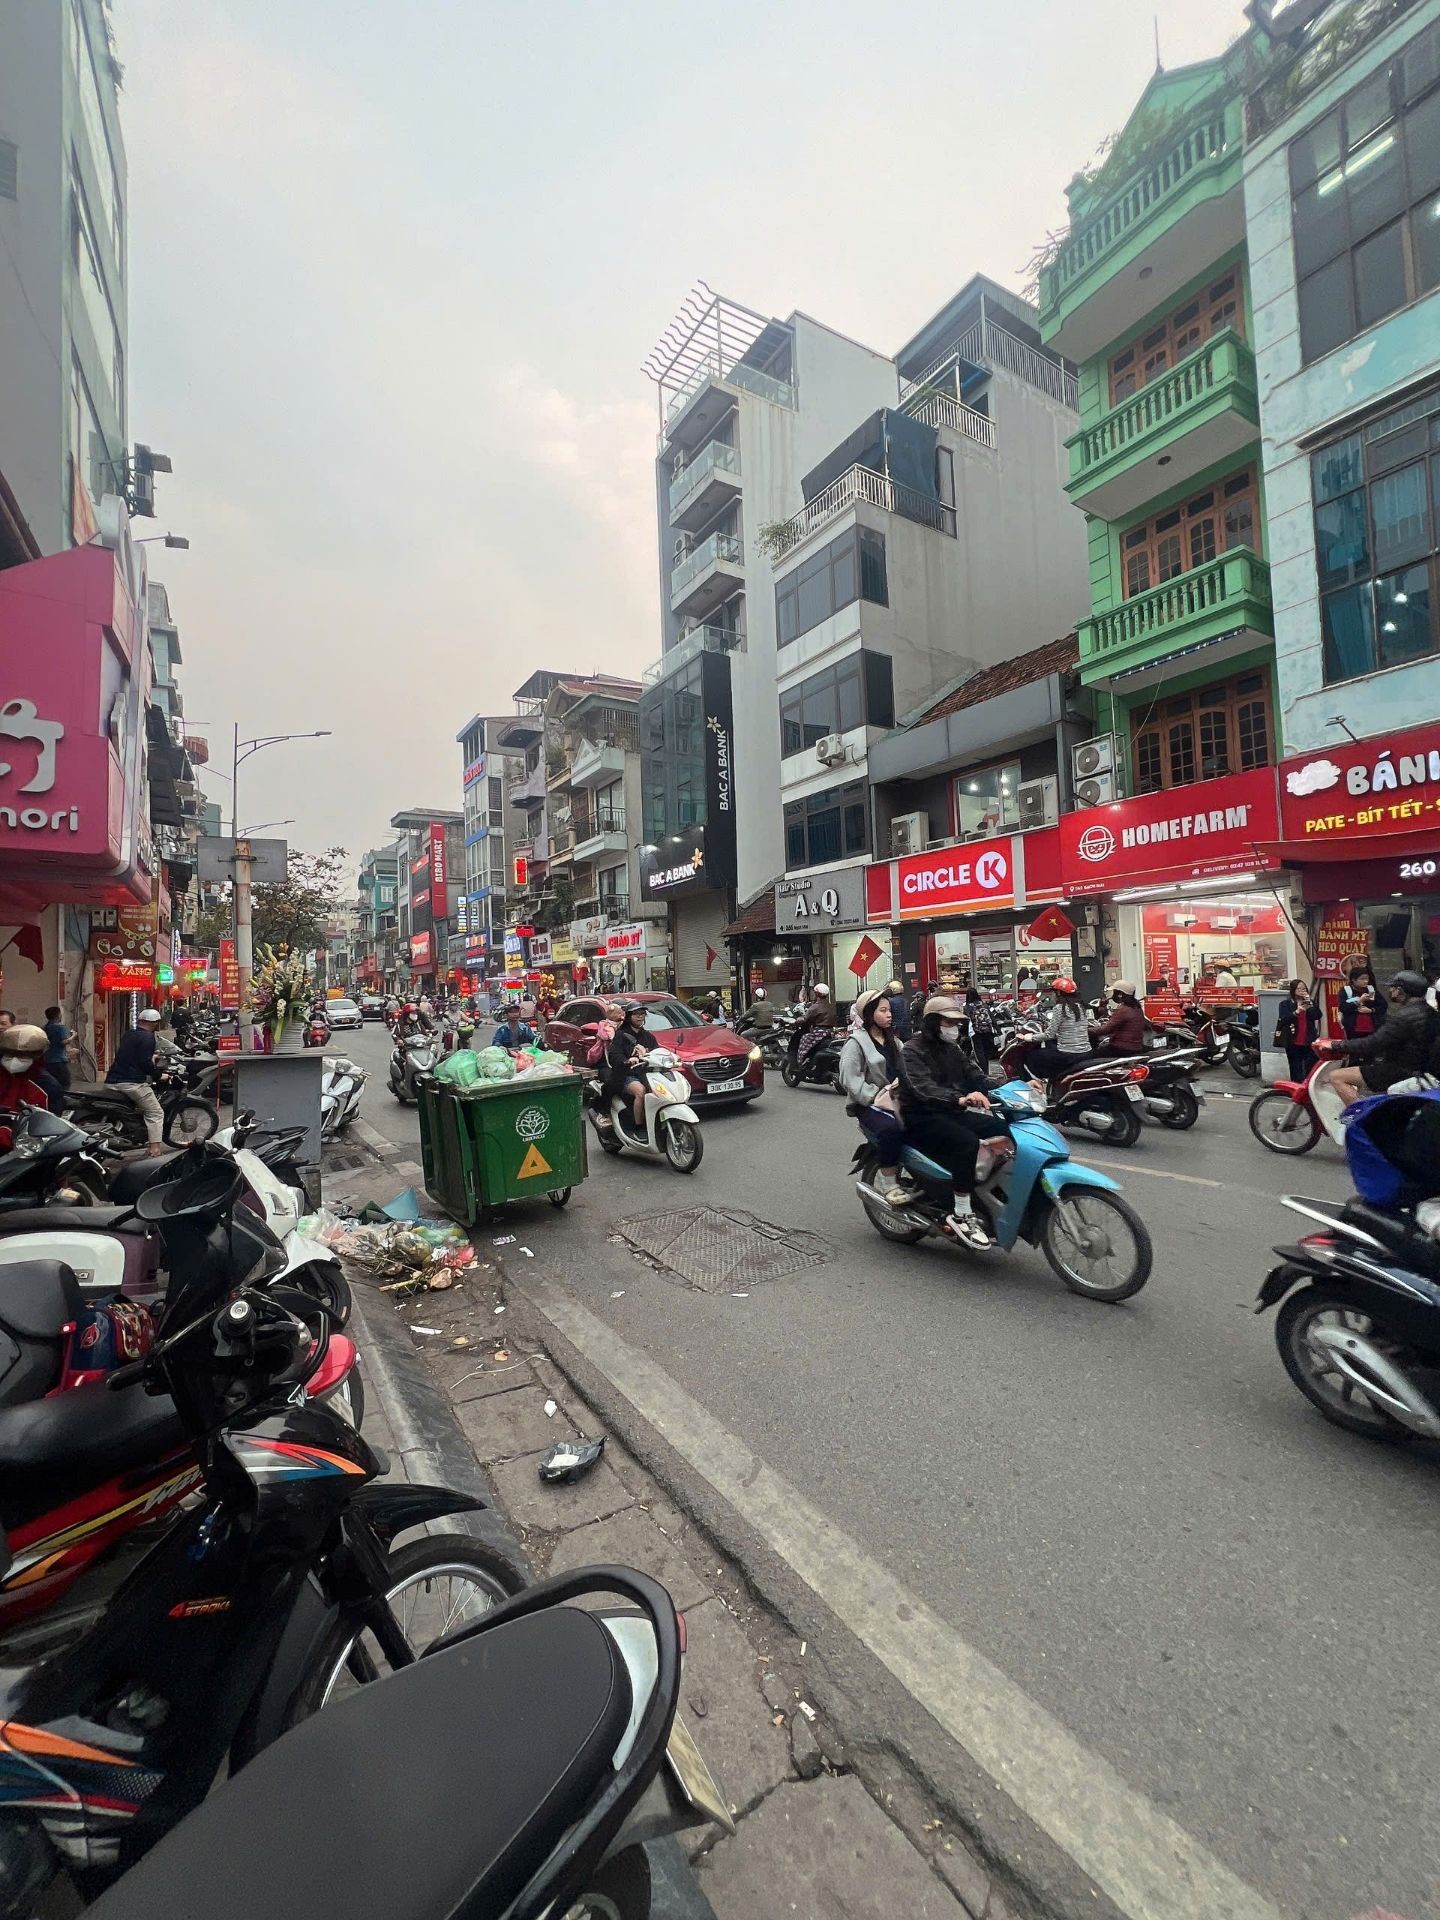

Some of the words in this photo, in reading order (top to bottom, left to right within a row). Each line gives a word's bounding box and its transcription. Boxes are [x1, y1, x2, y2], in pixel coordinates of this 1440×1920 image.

[717, 729, 729, 768] BANK
[718, 770, 728, 781] A
[719, 783, 729, 811] BAC
[1121, 804, 1248, 848] HOMEFARM
[1305, 814, 1346, 833] PATE
[1356, 805, 1385, 825] BÍT
[1387, 798, 1423, 820] TẾT
[433, 839, 443, 862] MART
[434, 862, 444, 883] BIBO
[649, 870, 666, 888] BAC
[665, 869, 674, 882] A
[673, 862, 697, 881] BANK
[903, 863, 972, 894] CIRCLE
[980, 855, 1005, 886] K
[1399, 860, 1437, 878] 260
[794, 894, 809, 917] A
[810, 902, 819, 915] &
[821, 888, 839, 917] Q
[1319, 930, 1349, 940] BÁNH
[1318, 942, 1337, 952] HEO
[1338, 942, 1366, 955] QUAY
